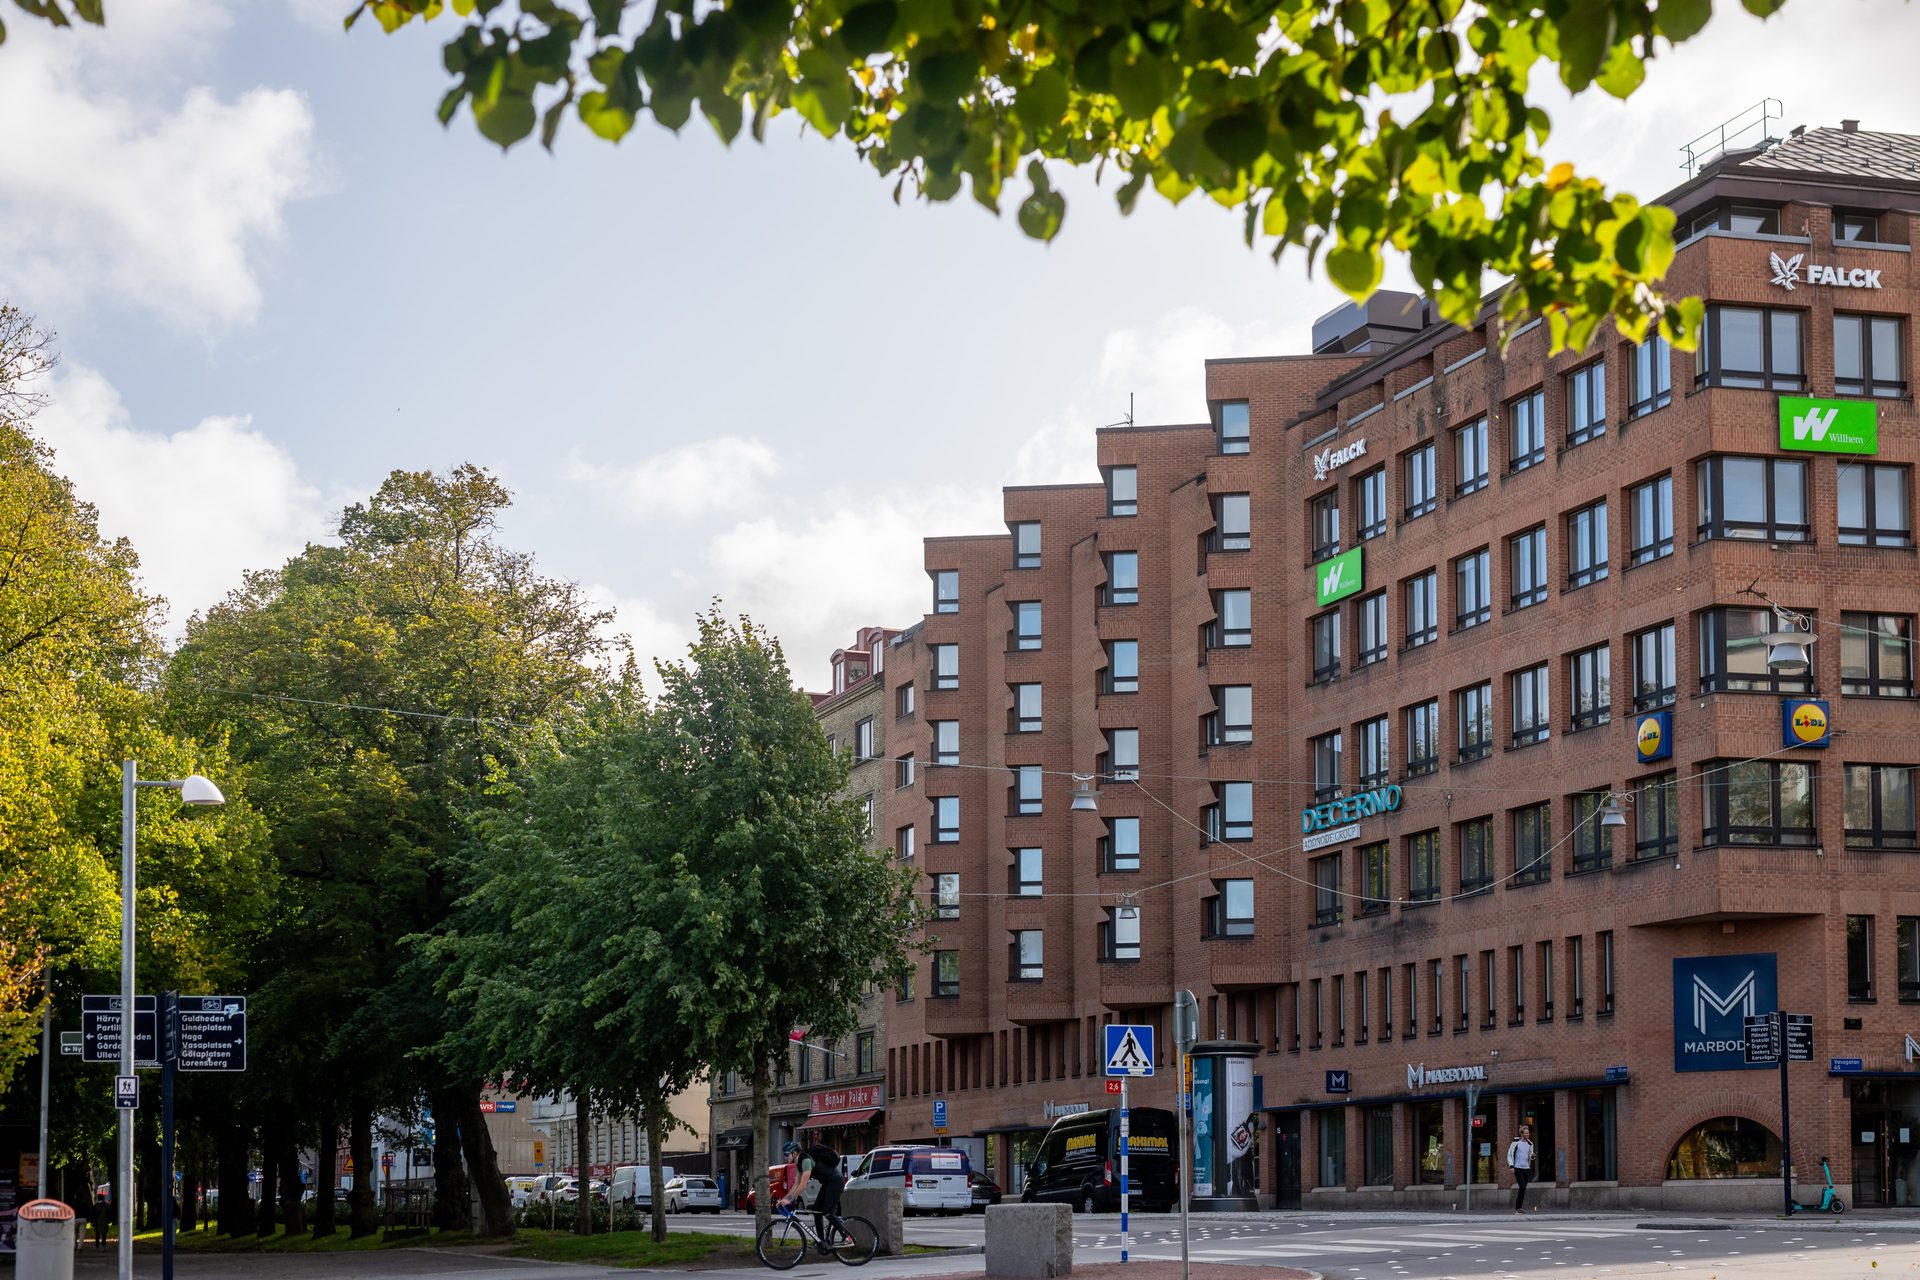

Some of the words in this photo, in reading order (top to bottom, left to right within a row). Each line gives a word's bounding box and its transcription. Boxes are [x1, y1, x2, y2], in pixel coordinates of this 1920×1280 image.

[1807, 265, 1882, 289] FALCK
[1829, 432, 1864, 444] Willhem
[1329, 438, 1367, 470] FALCK
[1301, 783, 1402, 833] DECERNO
[96, 1015, 121, 1023] Härry
[181, 1024, 232, 1032] Linnéplatsen
[181, 1033, 202, 1041] Haga
[182, 1042, 232, 1050] Vasaplatsen
[1684, 1040, 1746, 1053] MARBOD
[97, 1051, 120, 1059] Ullevi
[181, 1050, 231, 1058] Götaplatsen
[181, 1059, 228, 1068] Lorensberg
[825, 1092, 846, 1108] Bombay
[849, 1088, 868, 1107] Palace
